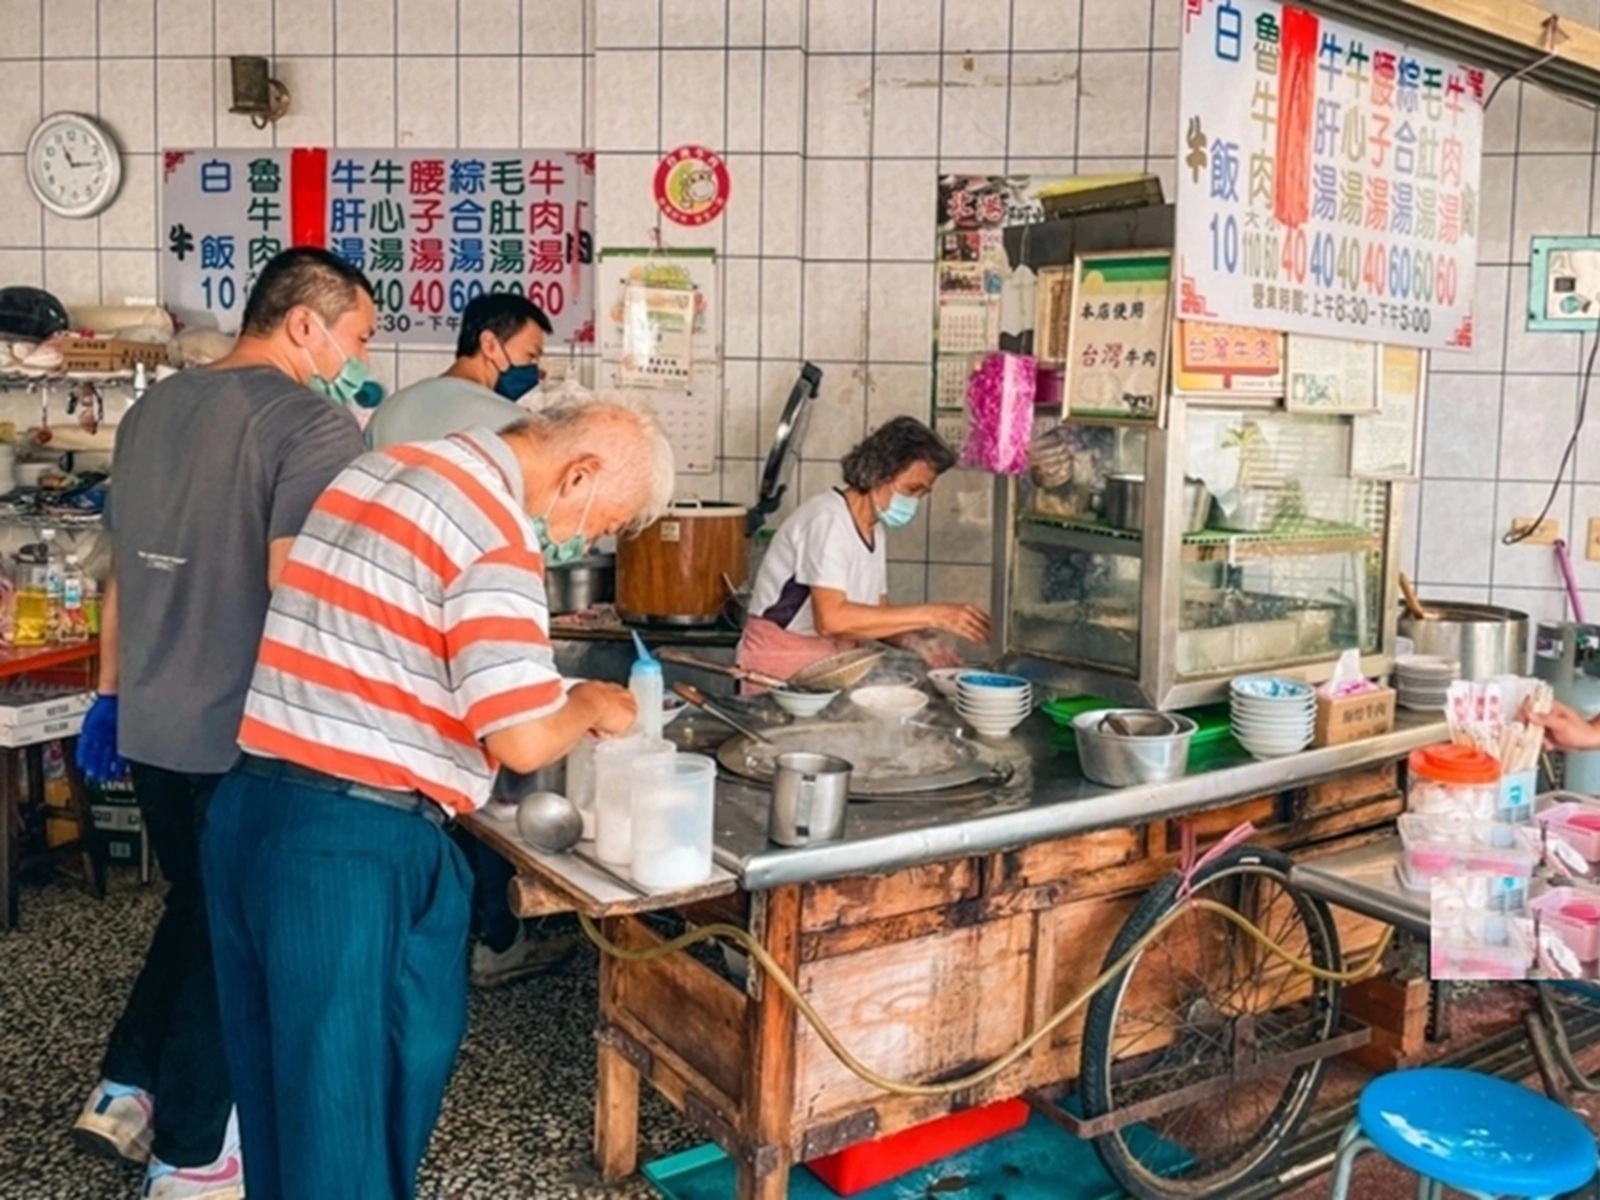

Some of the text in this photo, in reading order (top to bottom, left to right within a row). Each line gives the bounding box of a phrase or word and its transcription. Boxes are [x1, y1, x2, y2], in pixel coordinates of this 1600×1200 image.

[1249, 11, 1280, 210] 魯牛肉
[1310, 32, 1344, 288] 牛肝湯 40
[1337, 40, 1370, 292] 牛心湯 40
[330, 160, 367, 274] 牛肝湯
[369, 160, 405, 274] 牛心湯
[449, 160, 487, 274] 綜合湯
[489, 160, 527, 275] 毛肚湯
[529, 160, 565, 275] 牛肉湯
[1363, 50, 1396, 297] 腰子湯 40
[1388, 56, 1421, 299] 綜合湯 60
[1412, 66, 1443, 302] 毛肚湯 60
[1435, 73, 1466, 307] 牛肉湯 60
[169, 223, 195, 262] 牛
[202, 276, 236, 311] 10
[409, 160, 446, 314] 腰子湯 40
[1209, 213, 1238, 274] 10
[1280, 227, 1308, 285] 40
[1081, 301, 1145, 321] 本店使用
[1082, 342, 1157, 369] 台灣牛肉
